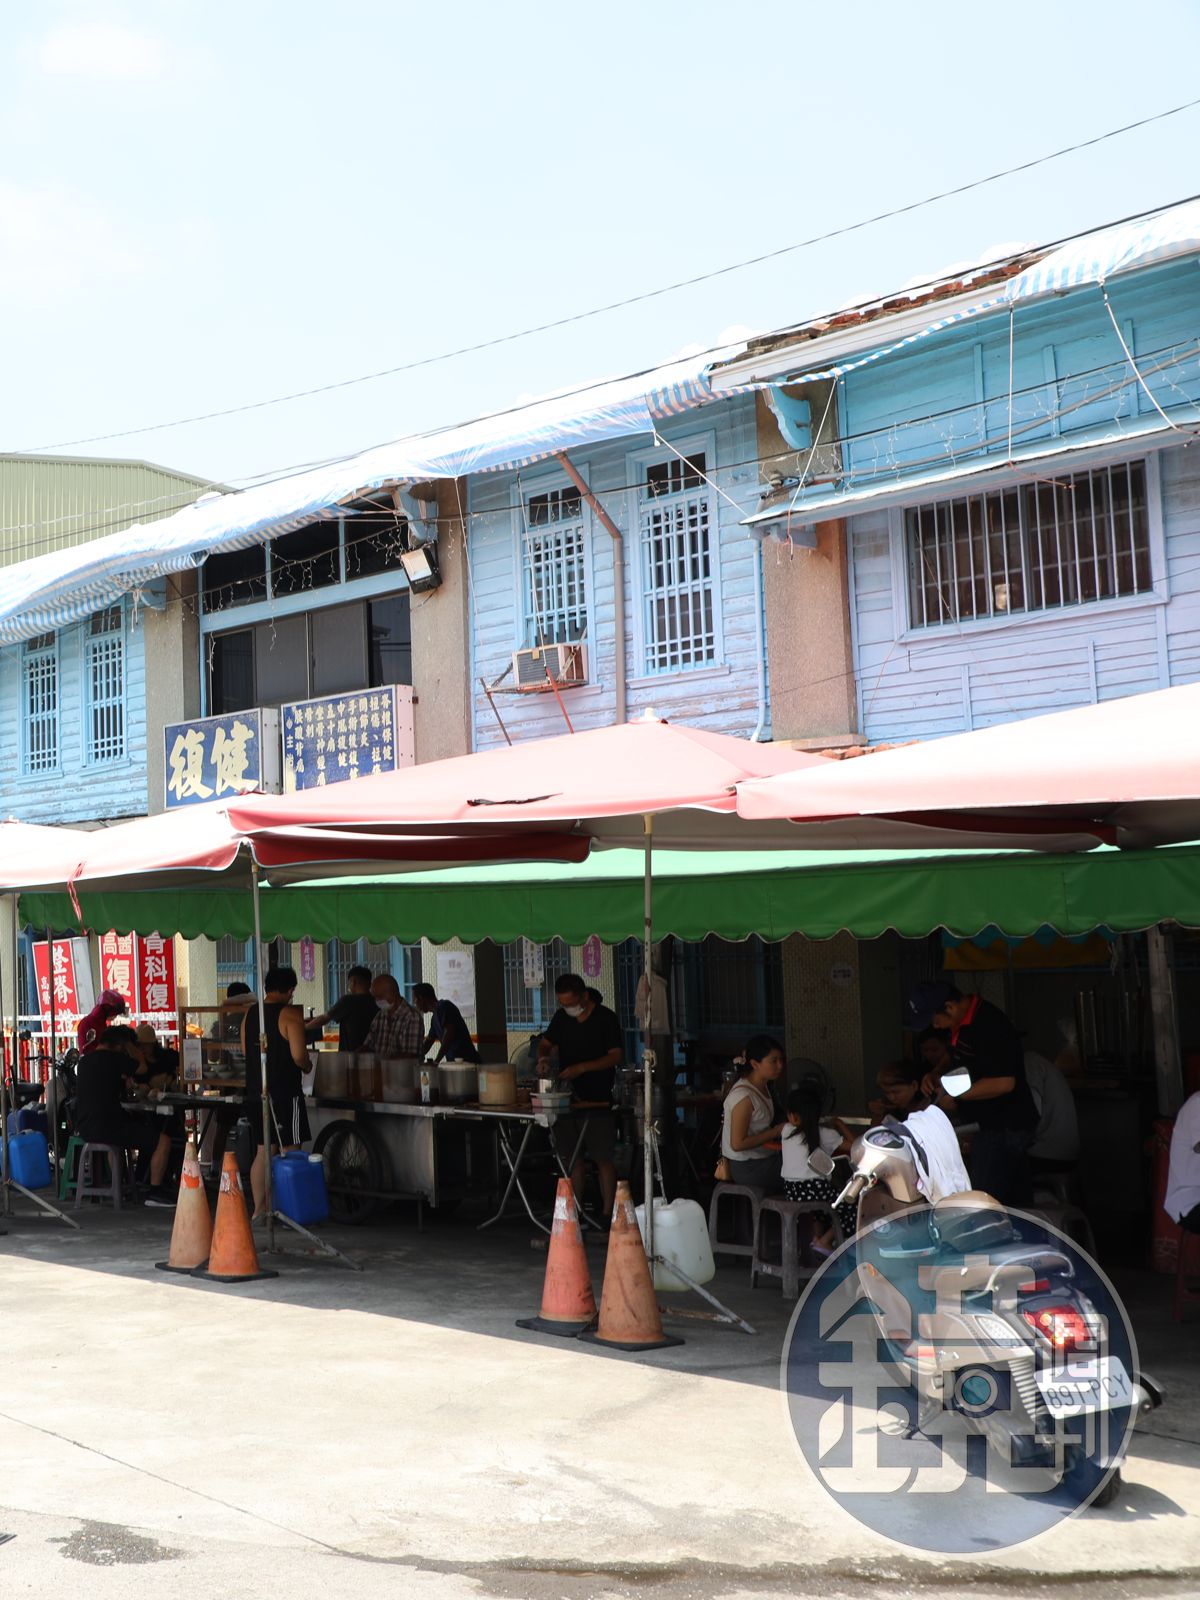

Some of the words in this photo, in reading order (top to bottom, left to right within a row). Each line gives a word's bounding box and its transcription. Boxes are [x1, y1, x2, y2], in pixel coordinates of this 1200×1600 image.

[304, 707, 315, 738] 骨刺
[326, 703, 336, 753] 五十肩
[337, 700, 348, 767] 中風復健
[381, 693, 393, 761] 脊椎保健
[168, 721, 259, 800] 復健
